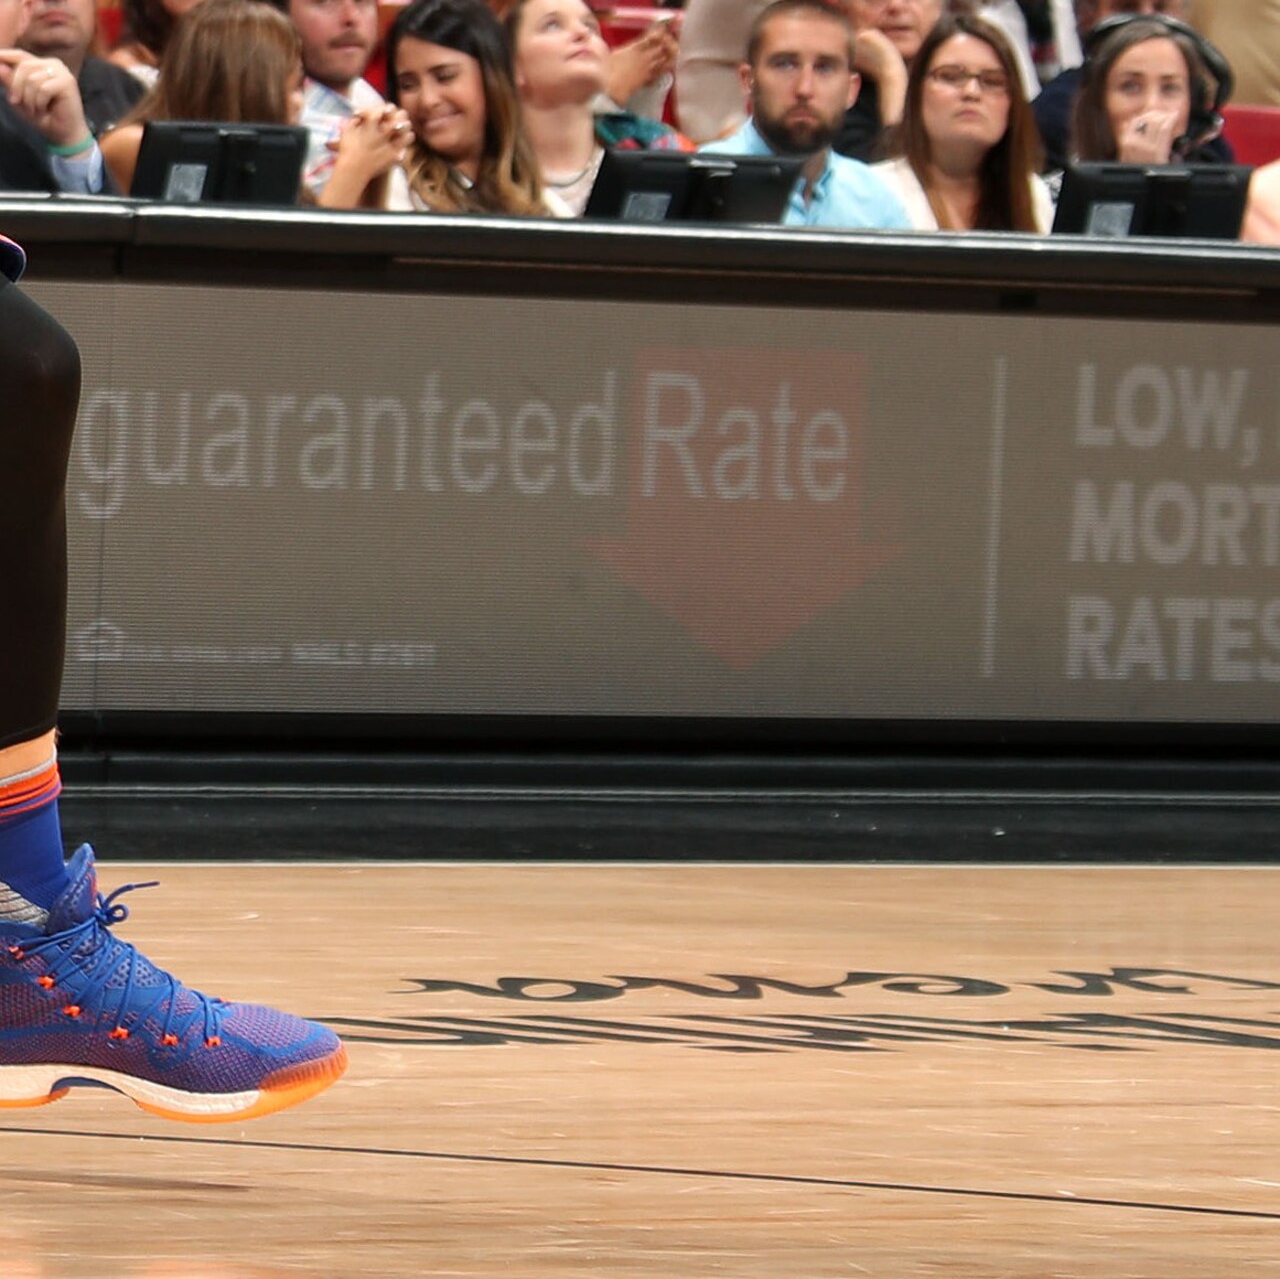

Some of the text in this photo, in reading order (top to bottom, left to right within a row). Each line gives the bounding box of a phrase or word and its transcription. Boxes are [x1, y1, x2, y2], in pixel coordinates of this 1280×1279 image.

[77, 369, 850, 519] guaranteed Rate
[1075, 364, 1262, 467] LOW,
